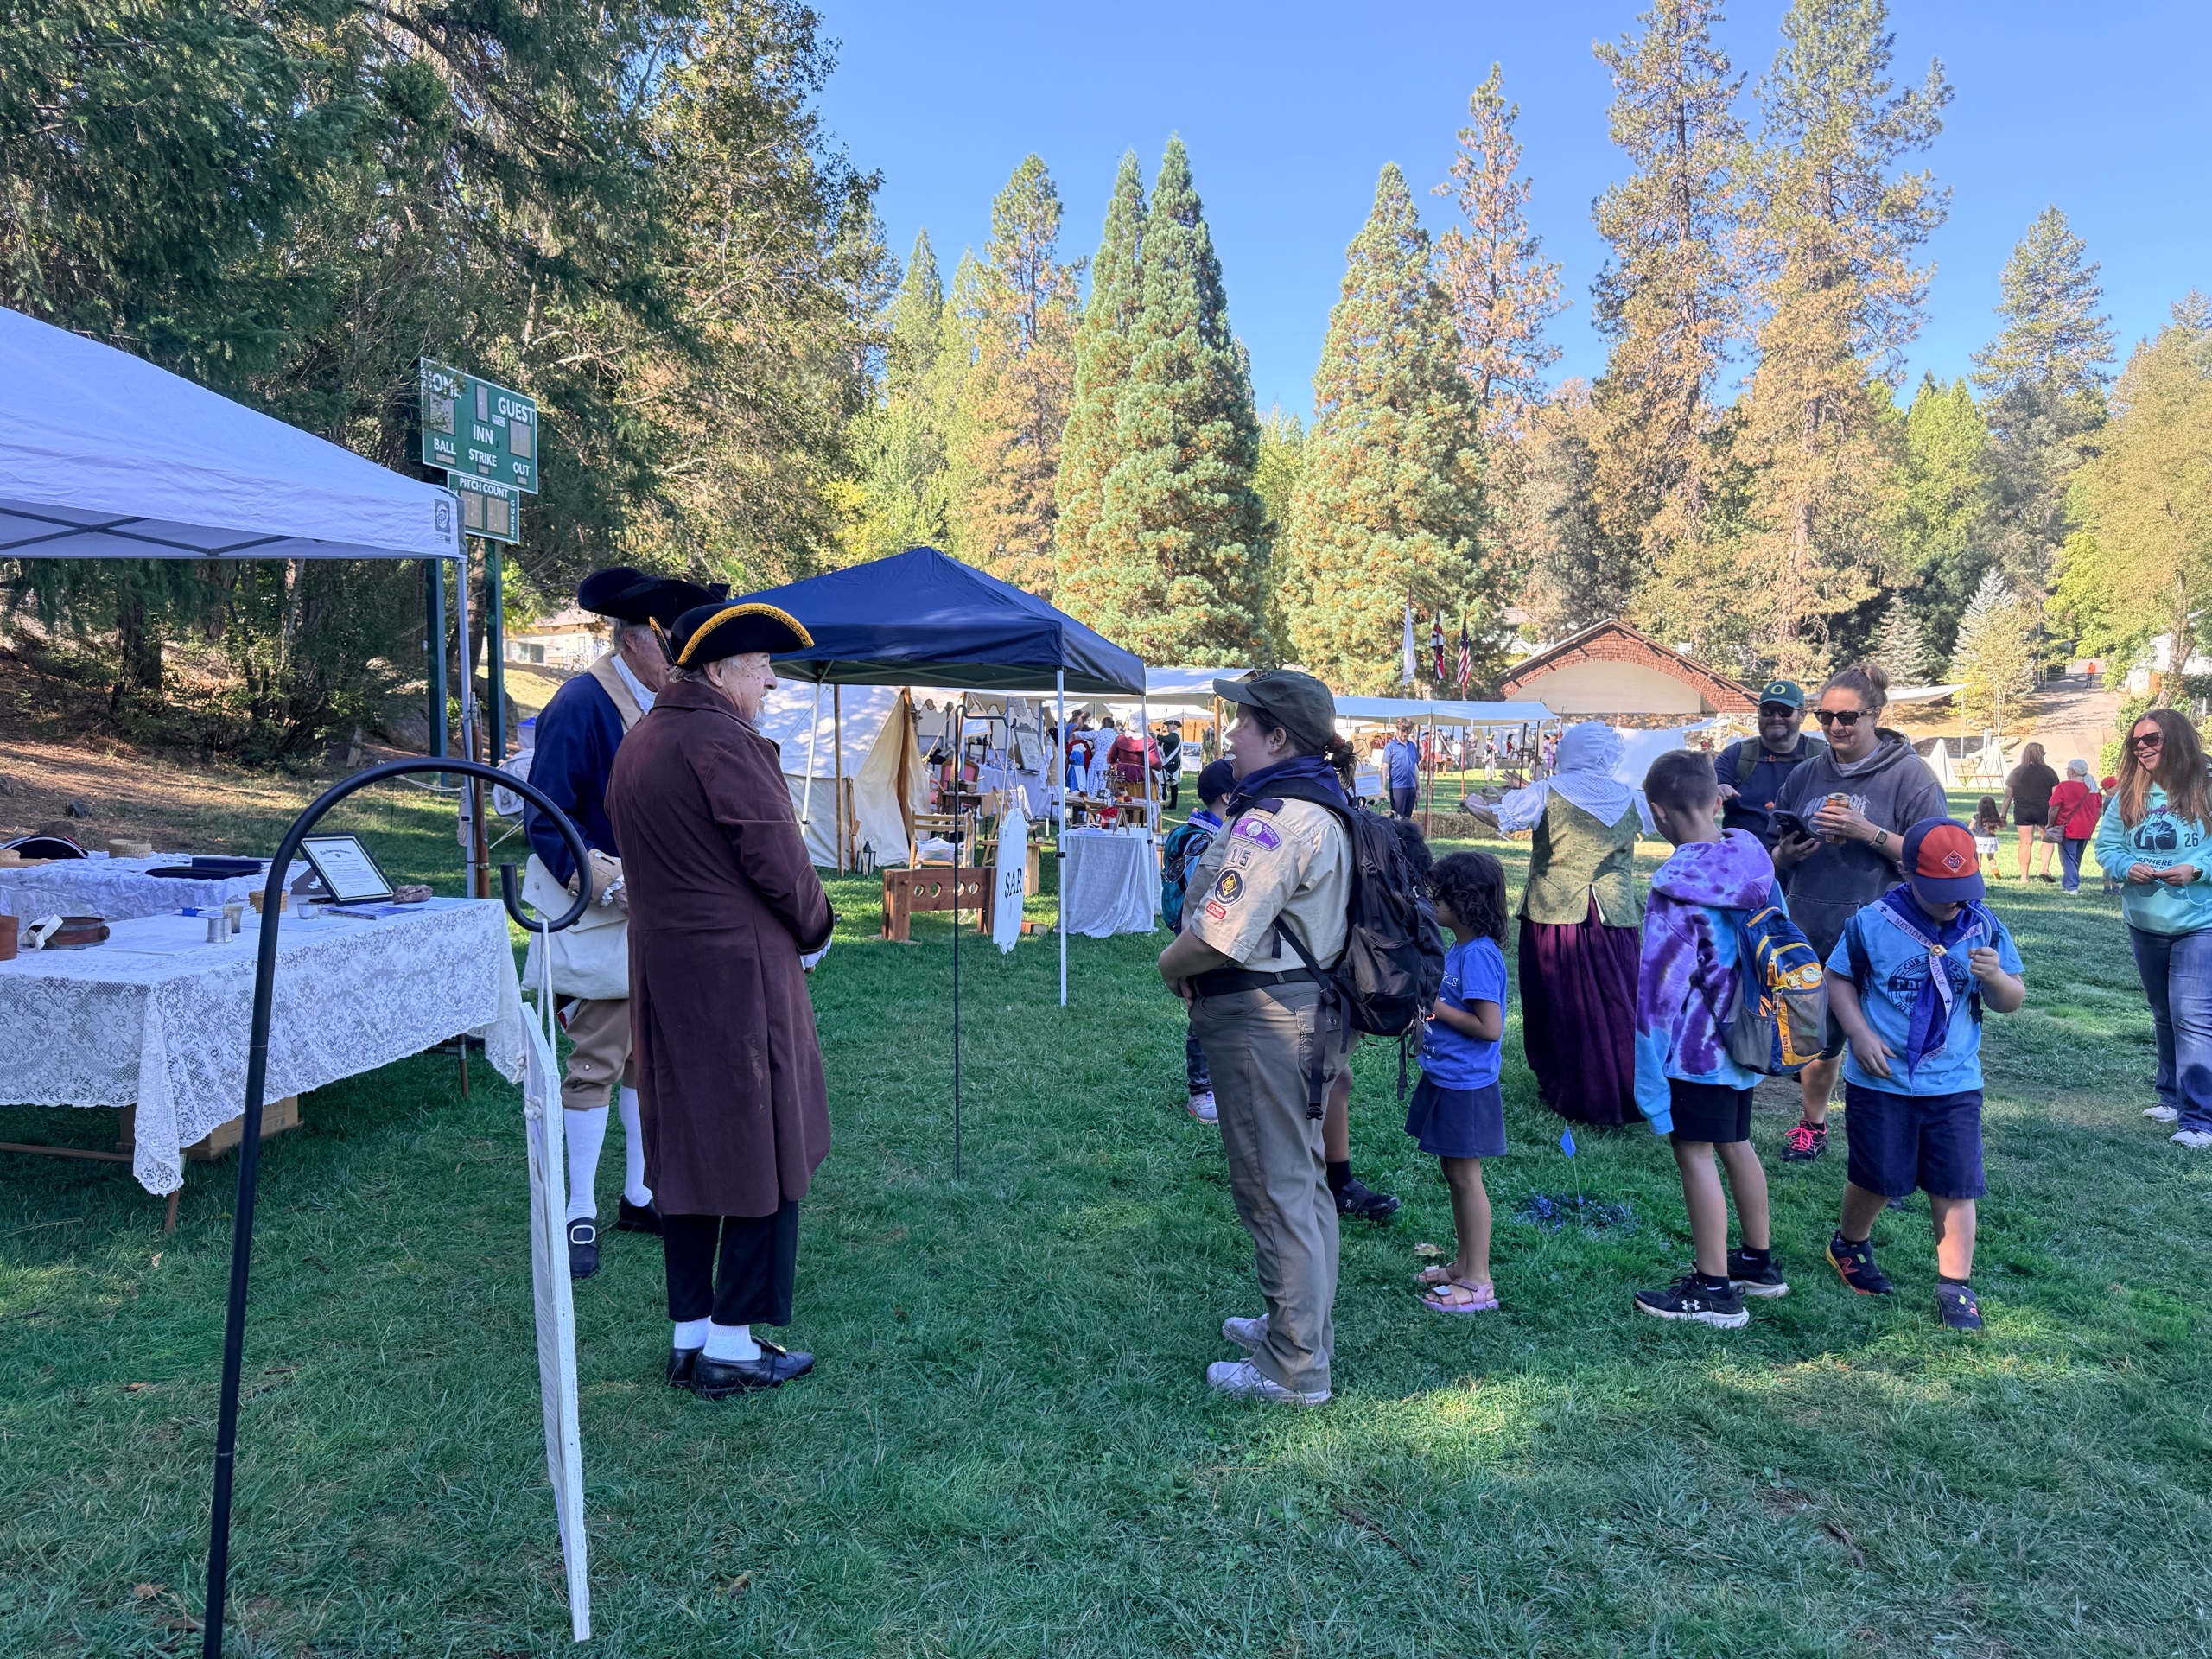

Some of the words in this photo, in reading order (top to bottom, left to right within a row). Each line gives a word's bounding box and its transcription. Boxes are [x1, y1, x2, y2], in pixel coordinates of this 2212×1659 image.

[498, 397, 536, 425] GUEST
[473, 423, 493, 445] INN
[434, 437, 457, 455] BALL
[468, 448, 498, 467] STRIKE
[512, 461, 531, 477] OUT
[459, 477, 482, 492] PITCH
[482, 484, 509, 499] COUNT
[2183, 832, 2199, 848] 26
[1229, 848, 1251, 867] 15
[1004, 868, 1022, 899] SAR
[1895, 918, 1922, 941] NEVADA
[1903, 958, 1921, 969] CUB
